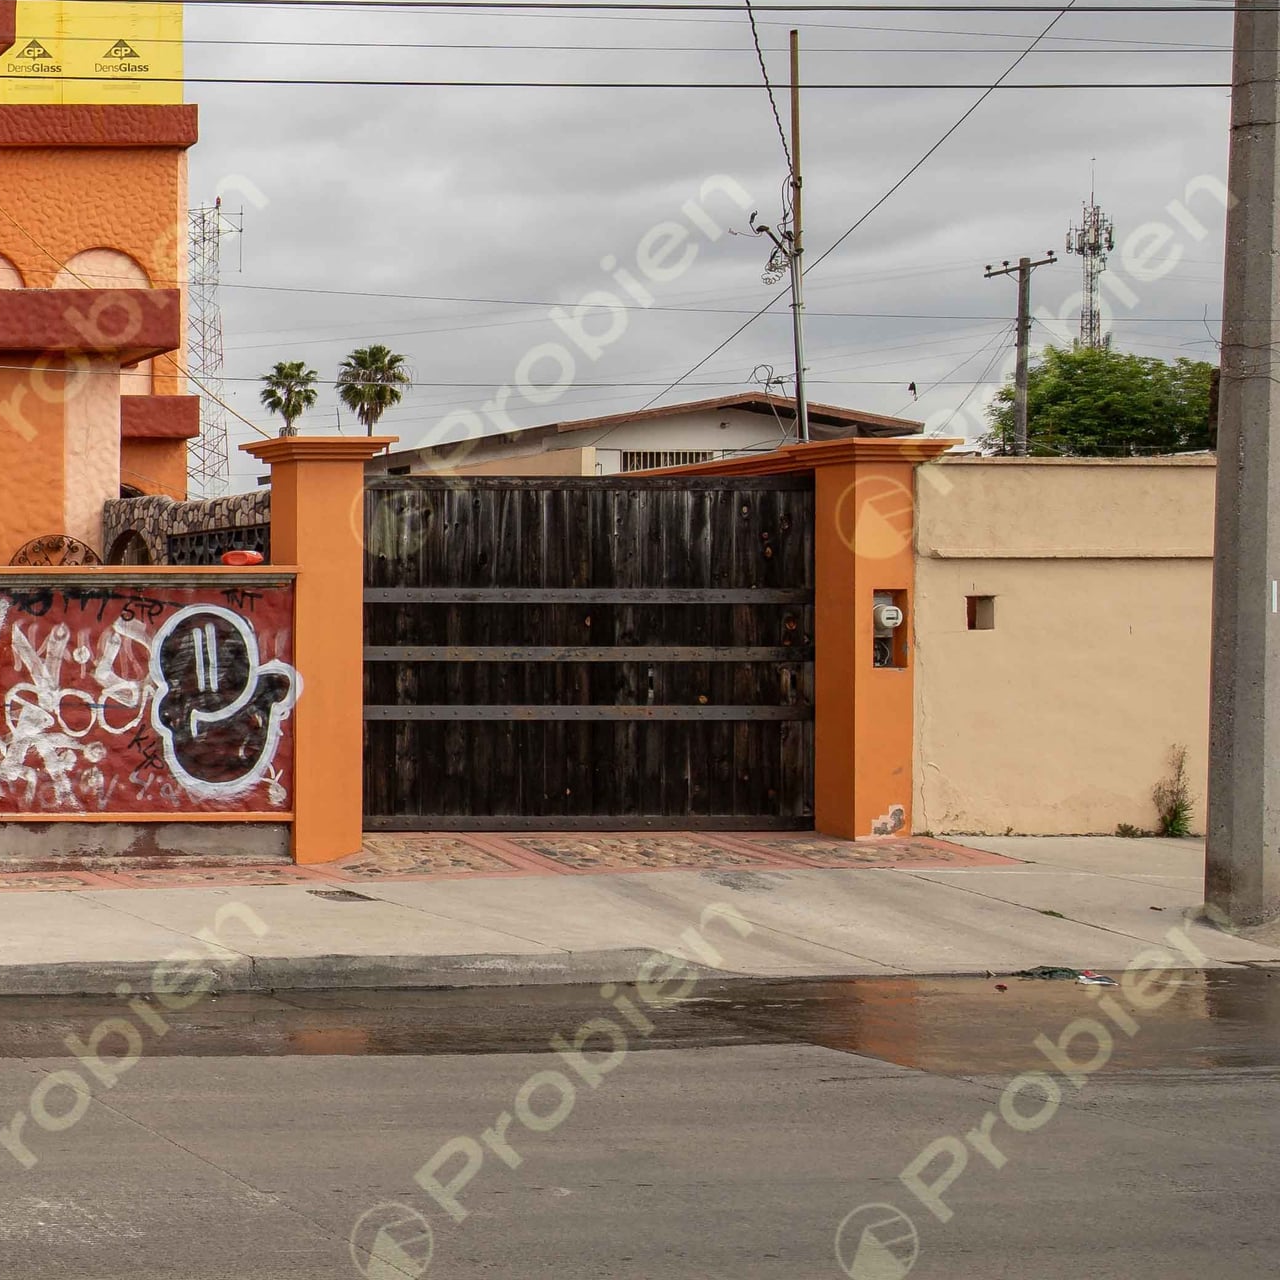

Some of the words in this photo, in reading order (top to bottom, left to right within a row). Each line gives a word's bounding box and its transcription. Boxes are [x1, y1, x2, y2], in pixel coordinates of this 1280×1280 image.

[23, 47, 44, 58] GP
[110, 46, 131, 57] GP
[7, 64, 62, 73] DensGlass
[95, 63, 149, 73] DensGlass
